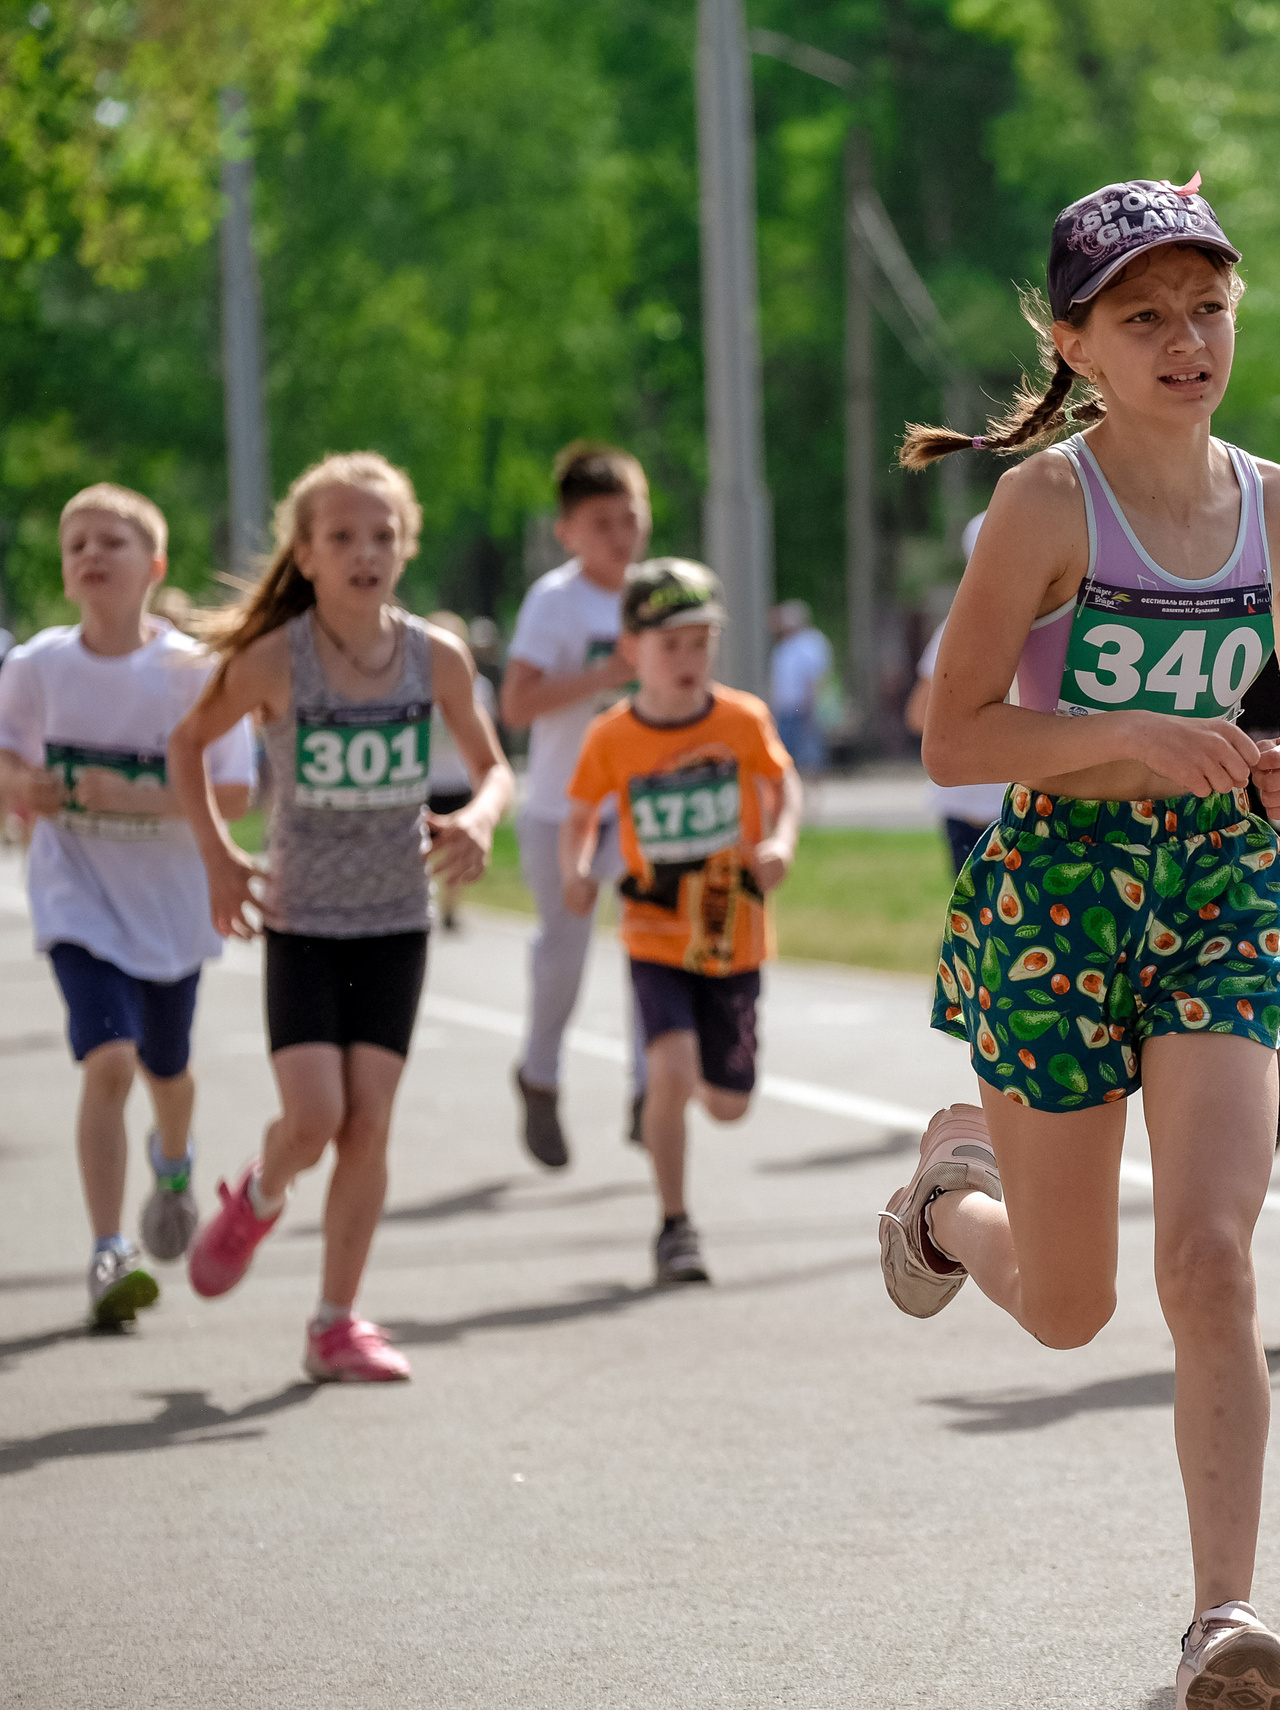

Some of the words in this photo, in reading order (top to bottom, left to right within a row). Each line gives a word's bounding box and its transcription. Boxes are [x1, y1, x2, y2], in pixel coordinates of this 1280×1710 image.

[1097, 209, 1194, 246] GLAM
[1141, 598, 1177, 606] ФЕСТИВАЛЬ
[1074, 624, 1263, 710] 340
[302, 725, 424, 785] 301
